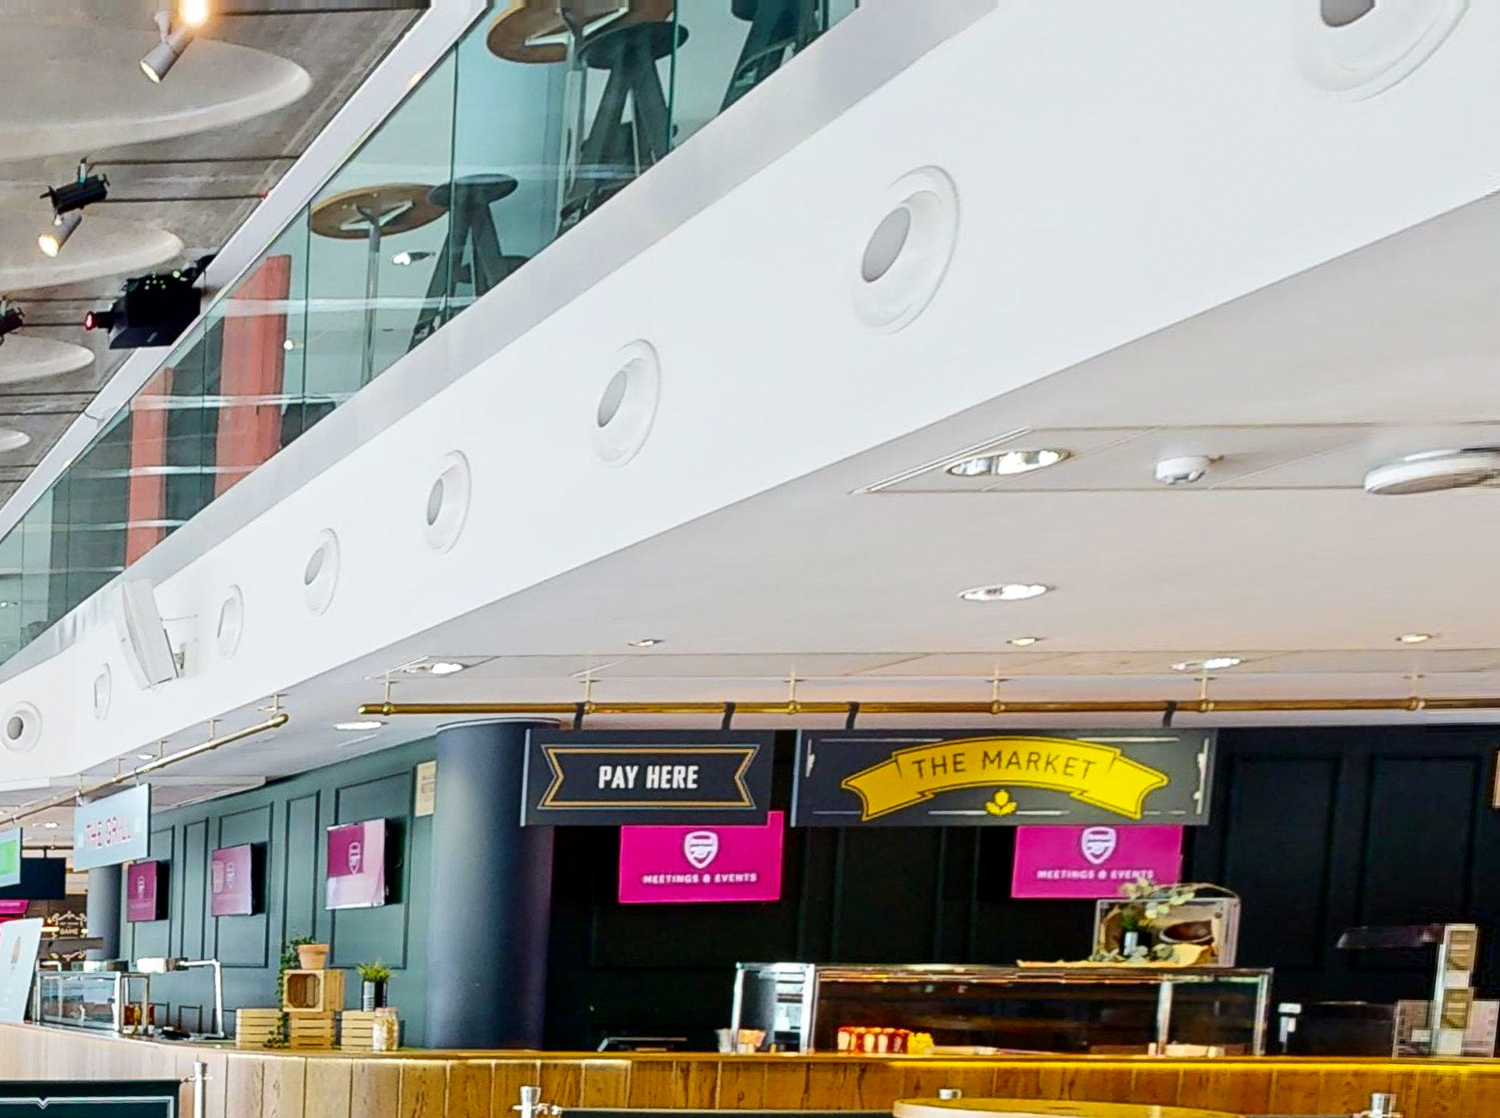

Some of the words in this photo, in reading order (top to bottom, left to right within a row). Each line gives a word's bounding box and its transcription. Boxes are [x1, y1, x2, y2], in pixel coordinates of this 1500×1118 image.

[598, 765, 639, 789] PAY
[646, 765, 699, 789] HERE
[912, 752, 966, 779] THE
[981, 750, 1097, 780] MARKET
[642, 874, 698, 884] MEETINGS
[714, 873, 757, 882] EVENTS
